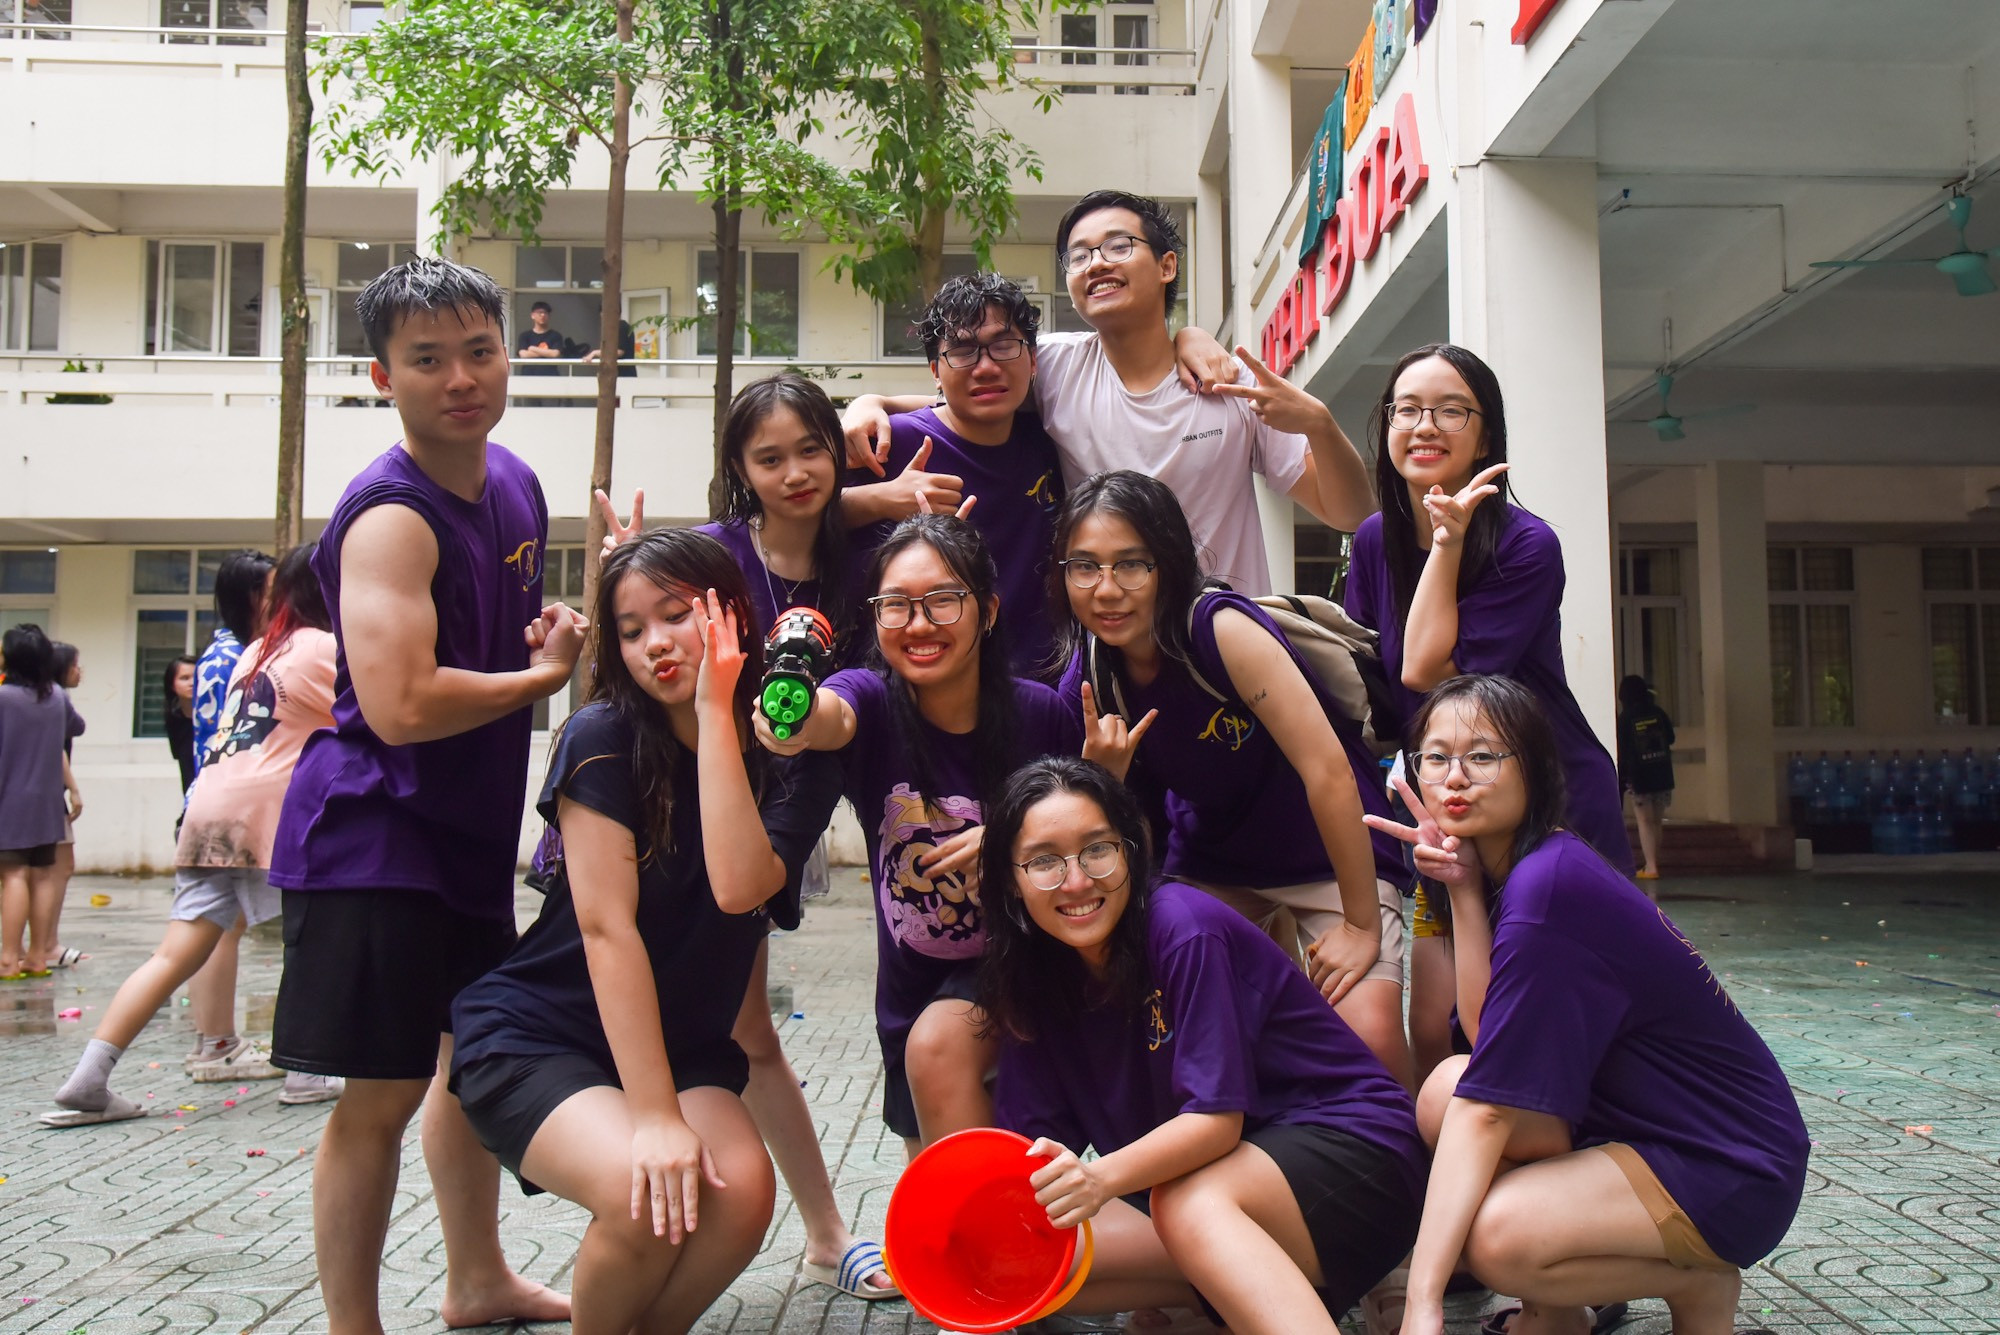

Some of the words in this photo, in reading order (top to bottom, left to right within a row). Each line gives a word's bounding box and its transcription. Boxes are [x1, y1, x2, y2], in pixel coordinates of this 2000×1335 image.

[1261, 247, 1320, 377] THI
[1322, 93, 1429, 316] ĐUA
[1182, 434, 1198, 442] RBAN
[1199, 429, 1223, 439] OUTFITS
